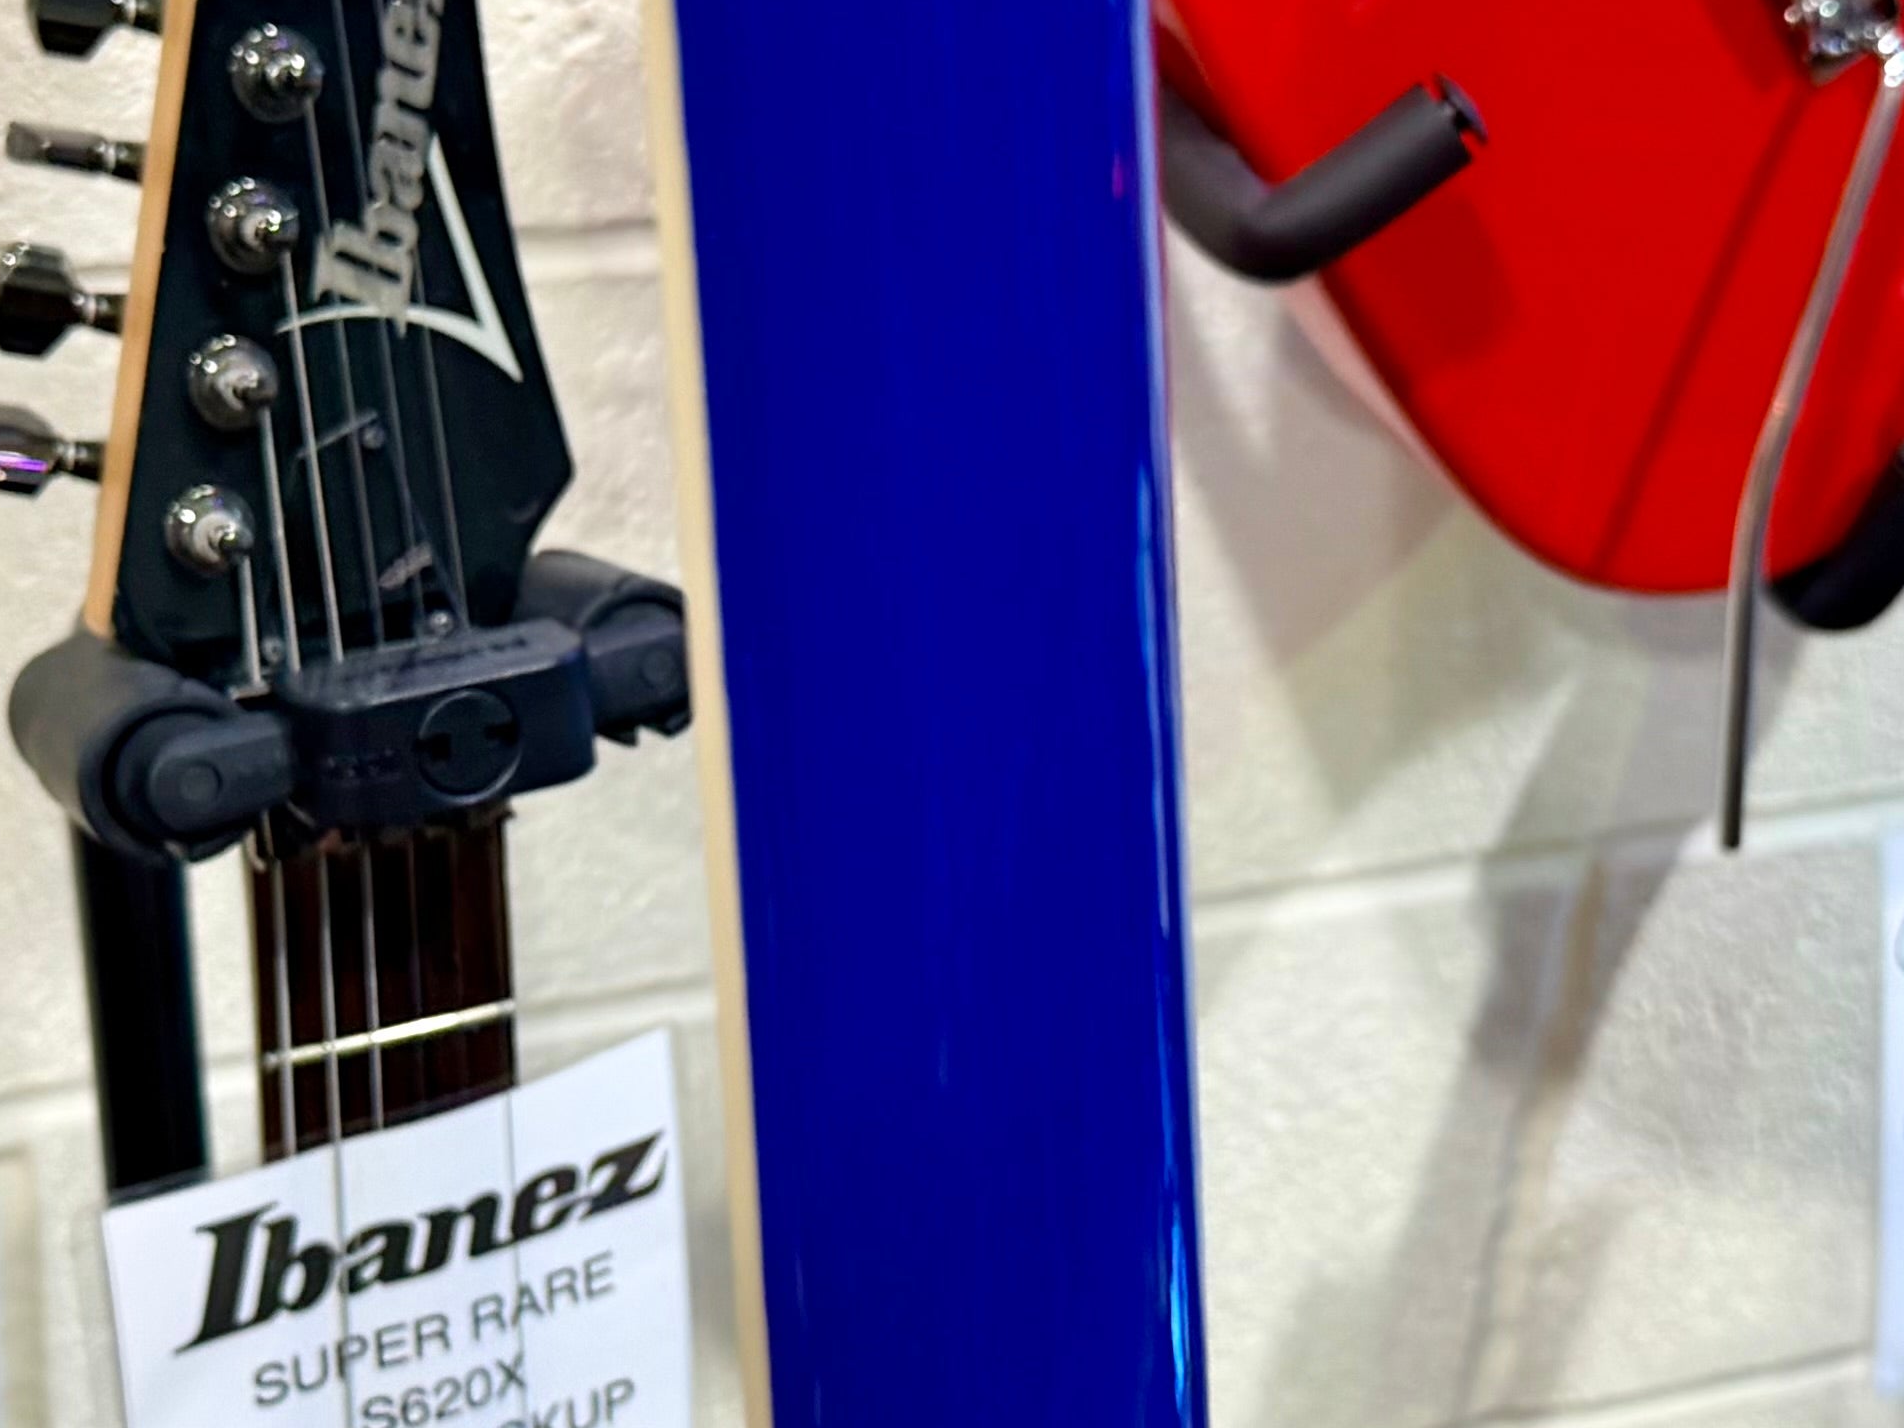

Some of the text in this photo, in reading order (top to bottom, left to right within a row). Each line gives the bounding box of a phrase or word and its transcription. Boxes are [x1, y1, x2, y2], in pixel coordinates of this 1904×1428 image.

[174, 1128, 668, 1356] Ibanez
[253, 1250, 618, 1410] SUPER RARE
